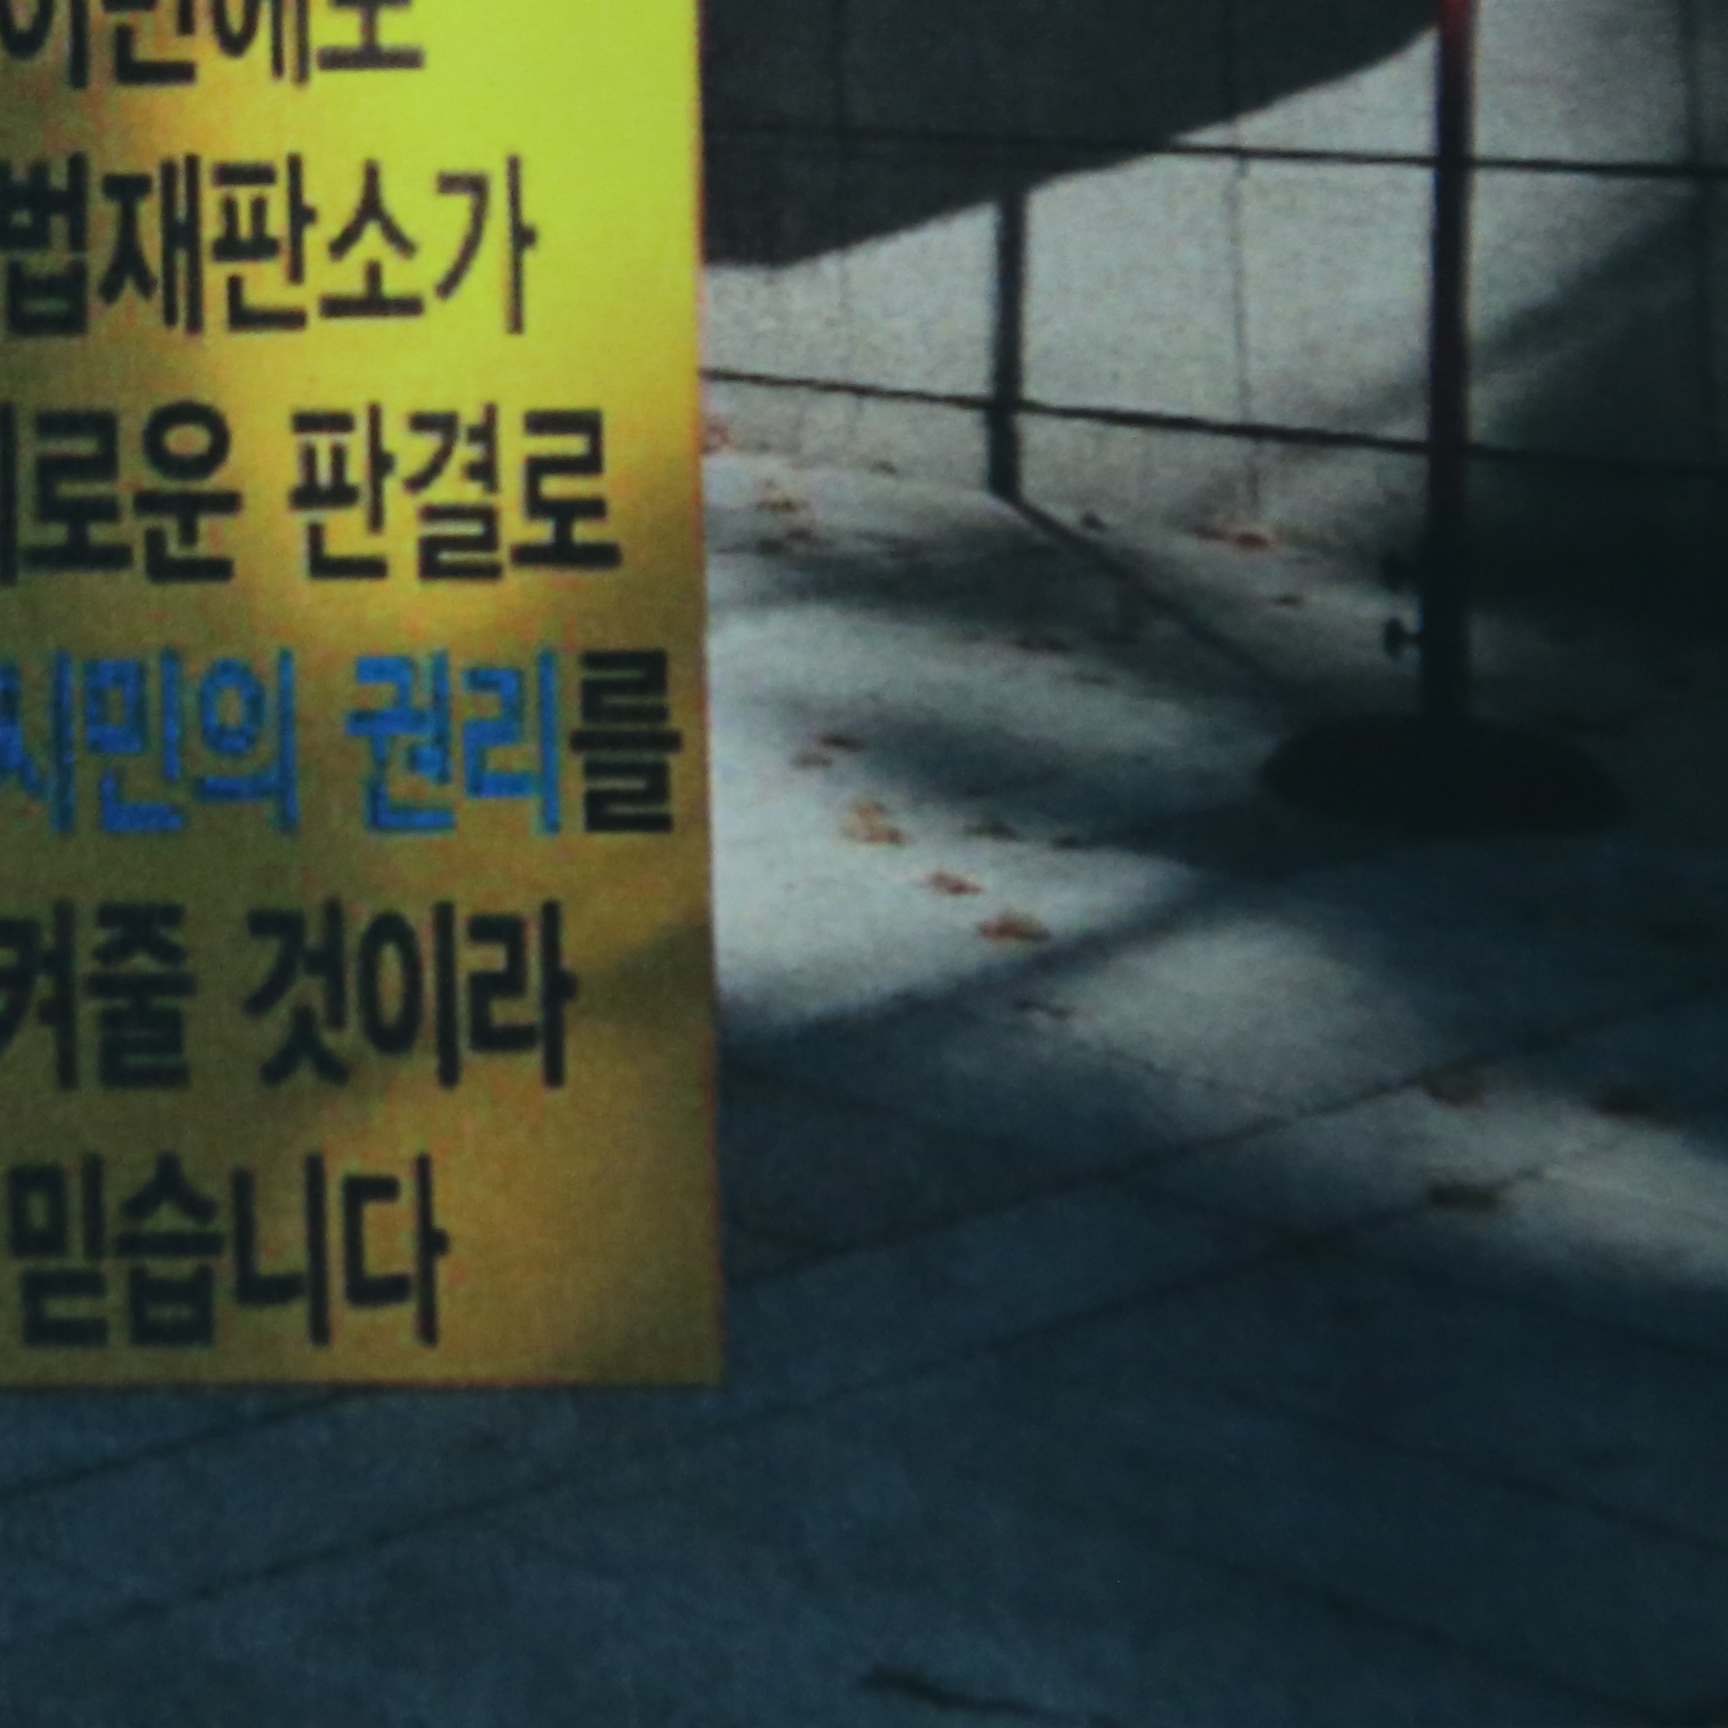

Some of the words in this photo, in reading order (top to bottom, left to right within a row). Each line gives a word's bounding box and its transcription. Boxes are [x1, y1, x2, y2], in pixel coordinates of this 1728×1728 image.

[289, 401, 622, 582] 판결로
[346, 645, 683, 836] 권리를
[244, 898, 578, 1088] 것이라
[6, 1150, 449, 1348] 믿습니다
